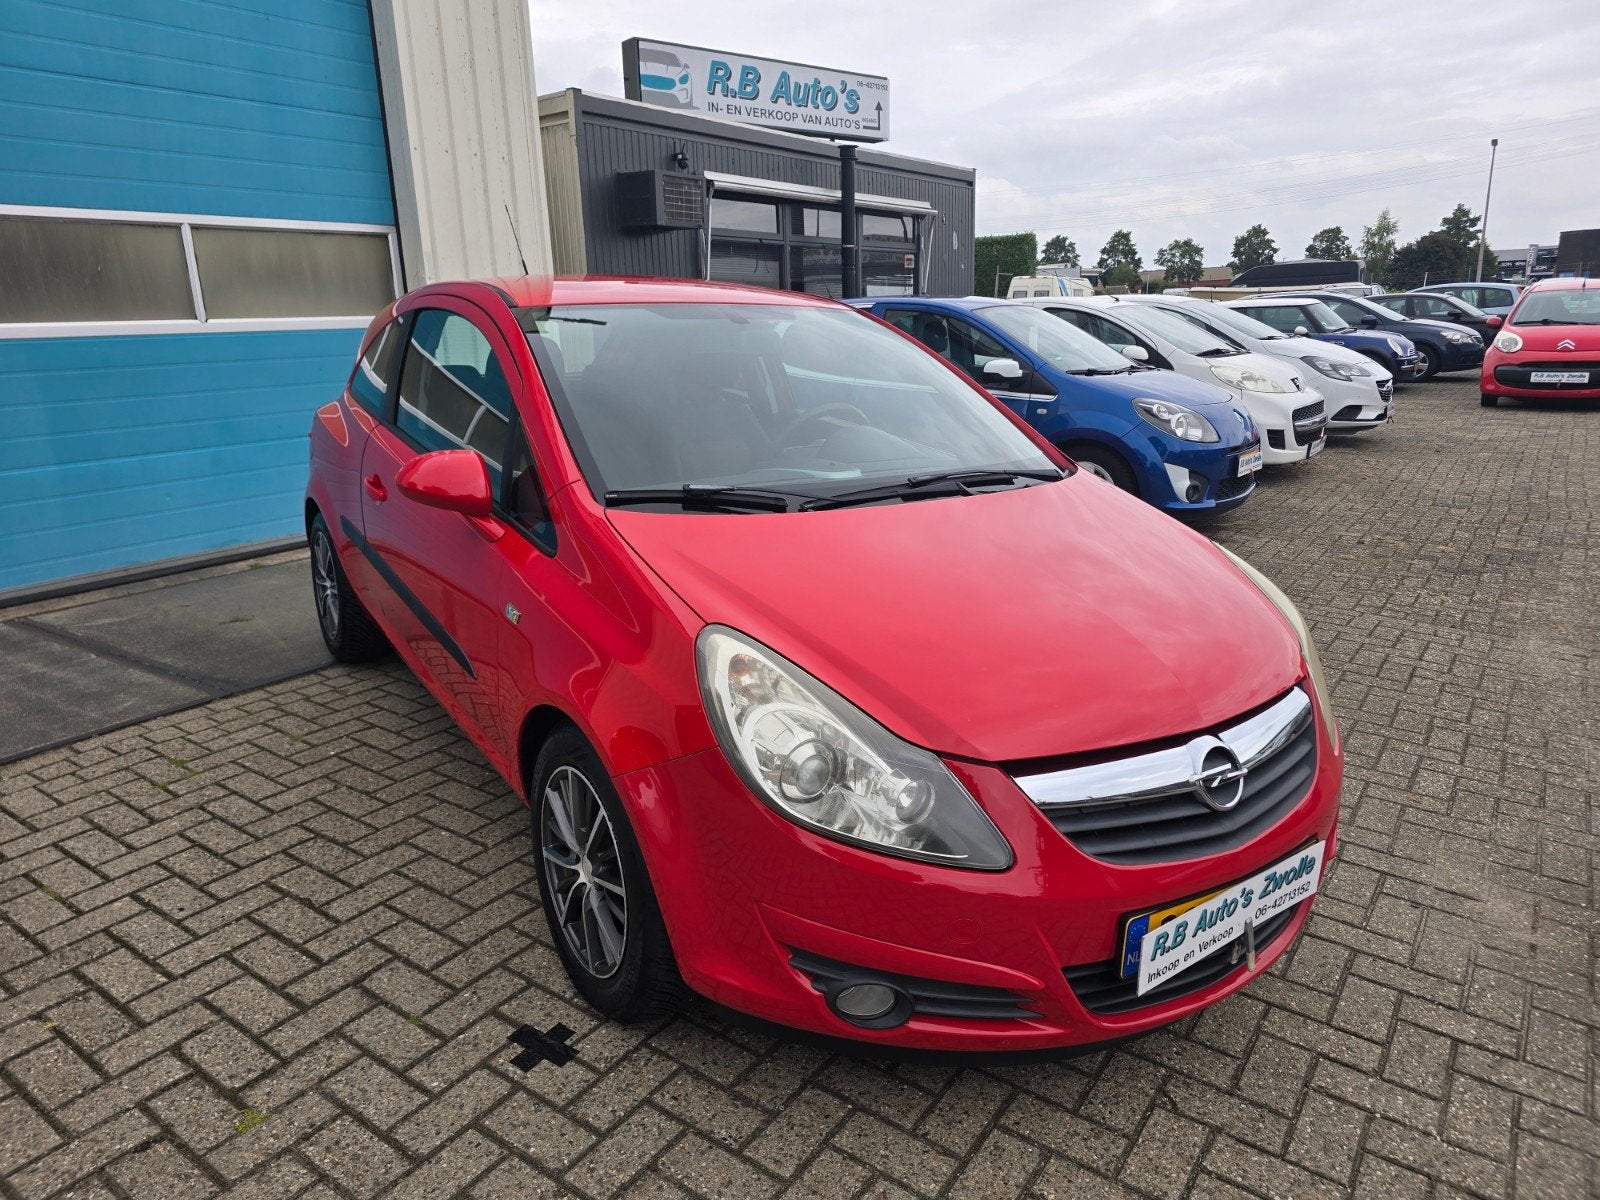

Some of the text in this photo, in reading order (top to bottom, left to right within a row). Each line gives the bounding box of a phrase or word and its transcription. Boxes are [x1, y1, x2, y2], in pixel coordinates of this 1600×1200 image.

[707, 60, 860, 114] R.B Auto's
[708, 102, 860, 129] IN- EN VERKOOP VAN AUTO'S
[1151, 855, 1316, 962] R.B Auto's Zwolle
[1255, 881, 1311, 919] 06-42713152
[1147, 927, 1234, 984] Inkoop en Verkoop
